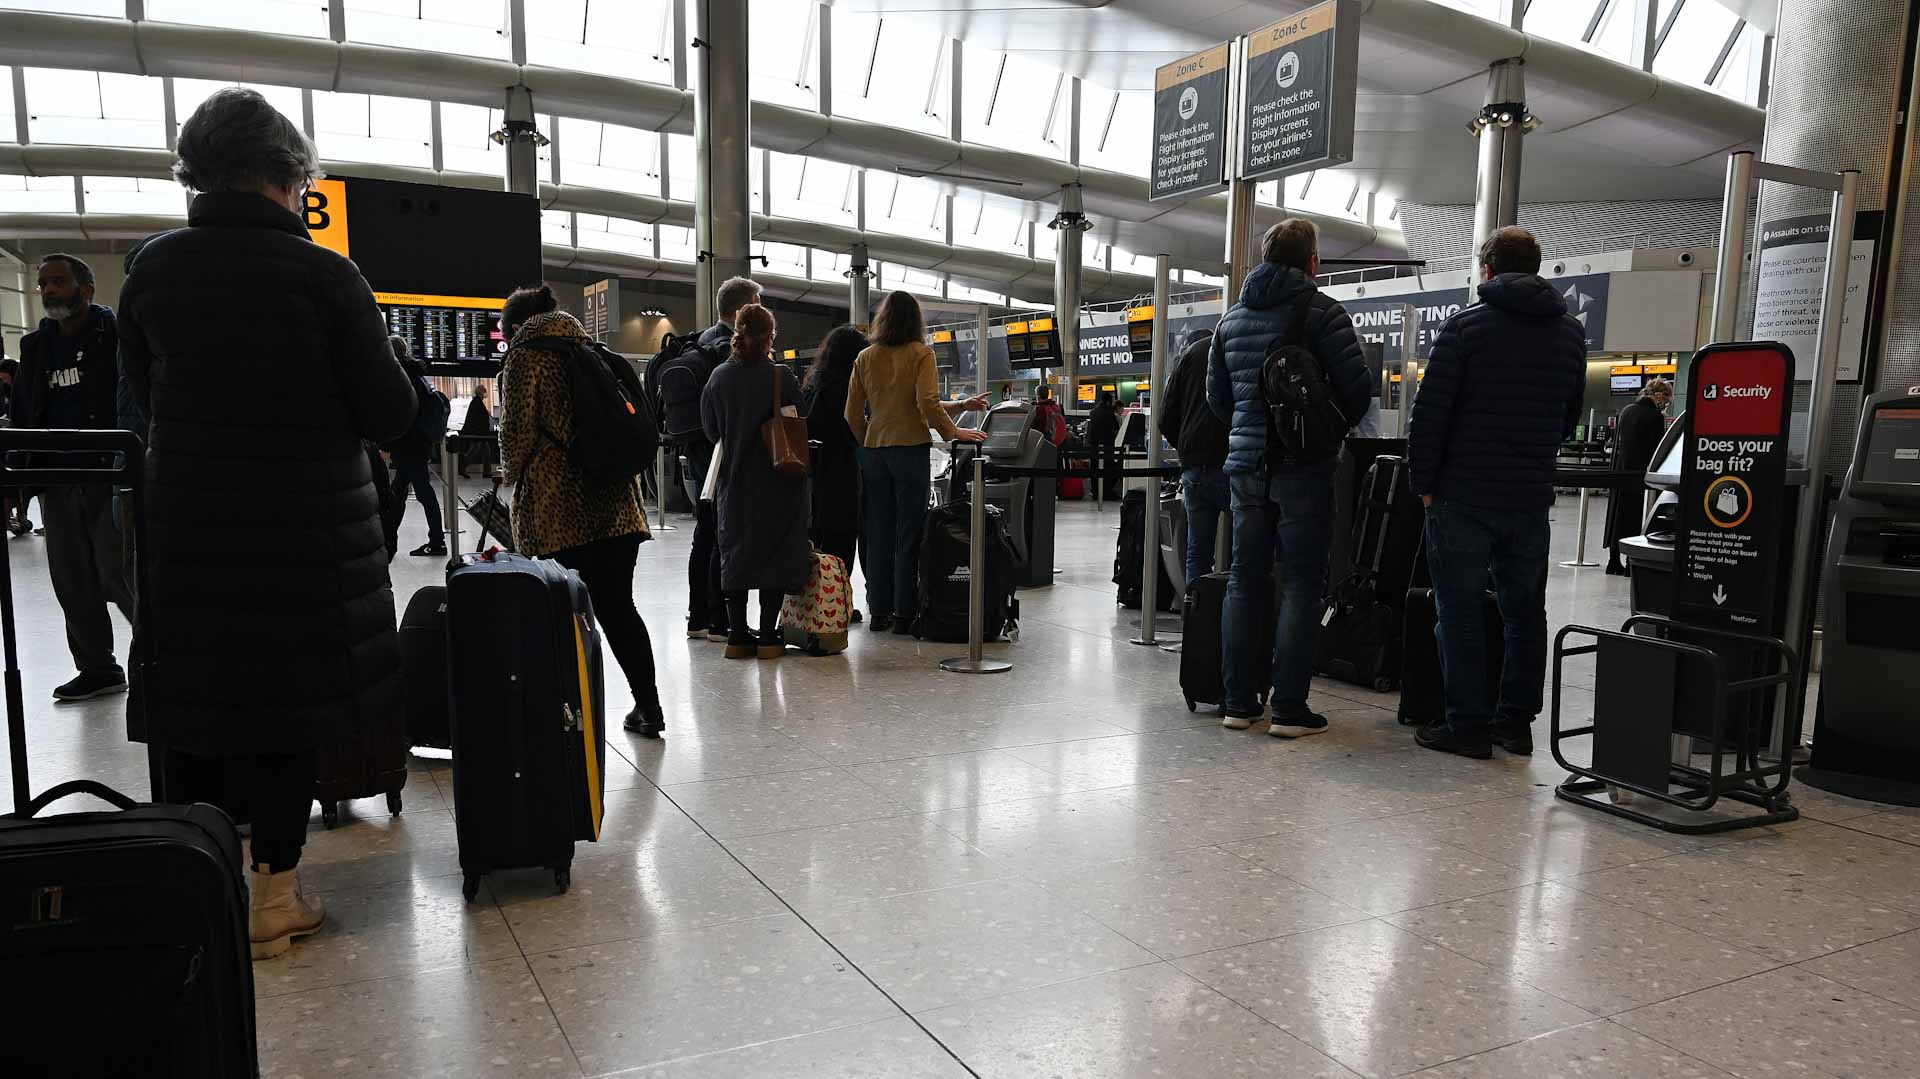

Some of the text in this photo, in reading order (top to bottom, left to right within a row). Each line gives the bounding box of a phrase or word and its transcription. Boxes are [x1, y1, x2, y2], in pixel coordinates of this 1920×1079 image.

[1272, 17, 1308, 41] Zone C
[1176, 56, 1207, 77] Zone C
[1253, 89, 1313, 115] Please check the
[1252, 100, 1320, 128] Flight Information
[1160, 121, 1209, 143] Please check the
[1251, 117, 1309, 141] Display screens
[1159, 132, 1215, 155] Flight Information
[1251, 143, 1263, 154] for
[1263, 138, 1281, 153] your
[1158, 147, 1205, 167] Display screens
[1250, 146, 1301, 167] check-in zone
[1158, 168, 1166, 178] for
[1167, 165, 1182, 178] your
[1157, 173, 1198, 189] check-in zone
[303, 191, 330, 231] B
[1769, 224, 1830, 239] Assaults on sta
[1793, 255, 1826, 265] courteo
[1786, 266, 1804, 276] with
[1806, 266, 1821, 274] our
[1793, 287, 1808, 295] has
[1772, 298, 1808, 308] tolerance
[1784, 317, 1820, 326] violence
[1781, 328, 1817, 338] prosecut
[1090, 352, 1110, 366] THE
[1723, 384, 1772, 400] Security
[1697, 437, 1774, 456] Does your
[1696, 455, 1754, 475] bag fit?
[1708, 531, 1723, 539] check
[1724, 532, 1737, 540] with
[1689, 545, 1710, 553] allowed
[1718, 547, 1731, 555] take
[1740, 549, 1758, 557] board
[1694, 554, 1716, 562] Number
[1724, 556, 1738, 566] bags
[1693, 572, 1713, 580] Weight
